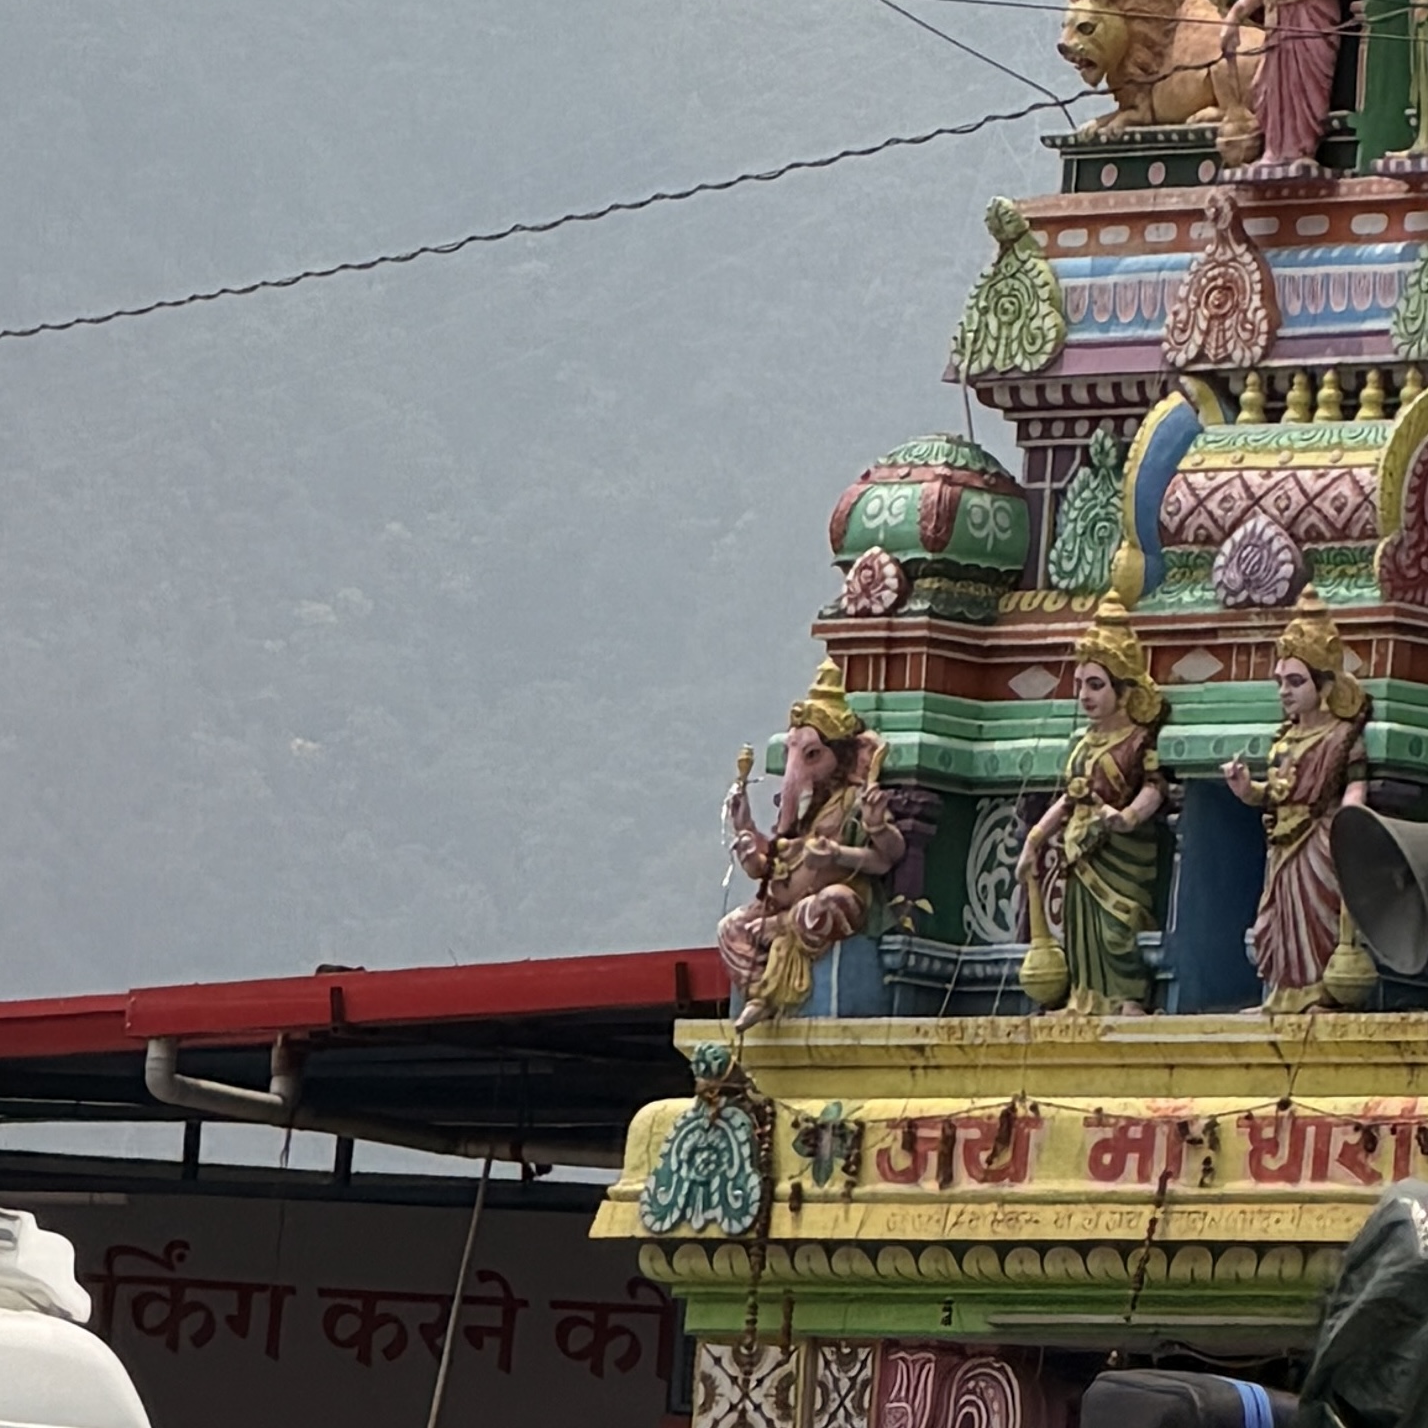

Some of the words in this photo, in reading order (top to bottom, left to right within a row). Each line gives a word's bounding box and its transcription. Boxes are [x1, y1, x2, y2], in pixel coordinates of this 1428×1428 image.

[875, 1114, 1043, 1188] जय
[83, 1238, 297, 1363] र्किंग
[317, 1268, 529, 1376] करने
